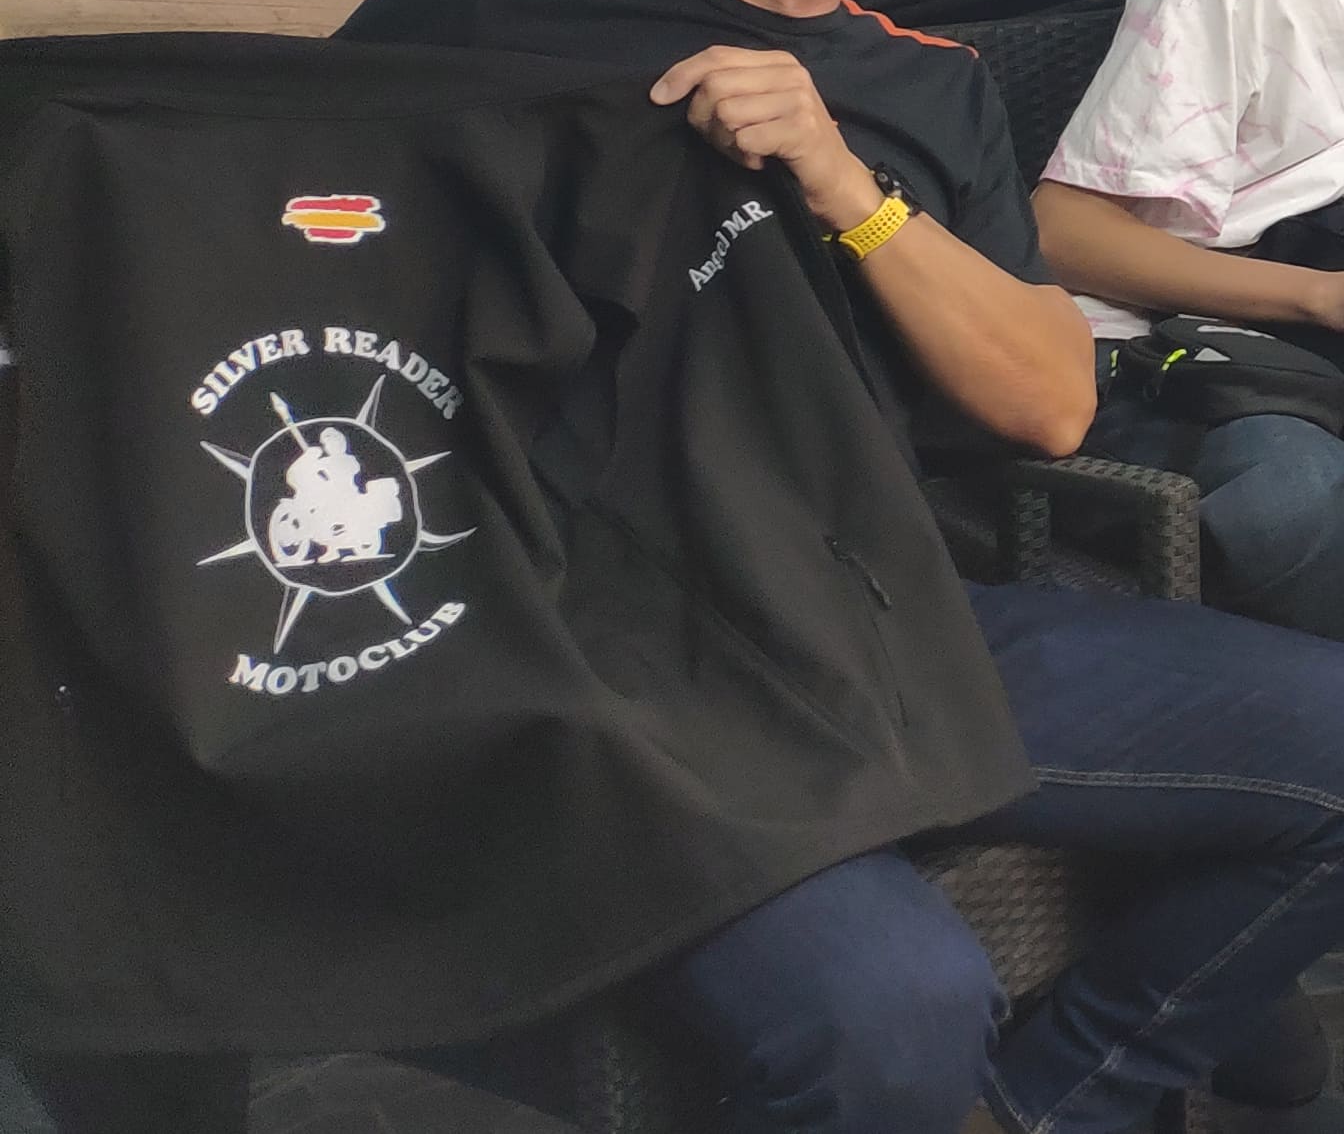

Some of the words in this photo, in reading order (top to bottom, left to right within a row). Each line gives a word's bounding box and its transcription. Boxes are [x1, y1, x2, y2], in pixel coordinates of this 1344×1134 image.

[190, 328, 310, 416] SILVER
[323, 326, 464, 420] READER
[226, 602, 467, 695] MOTOCLUB
